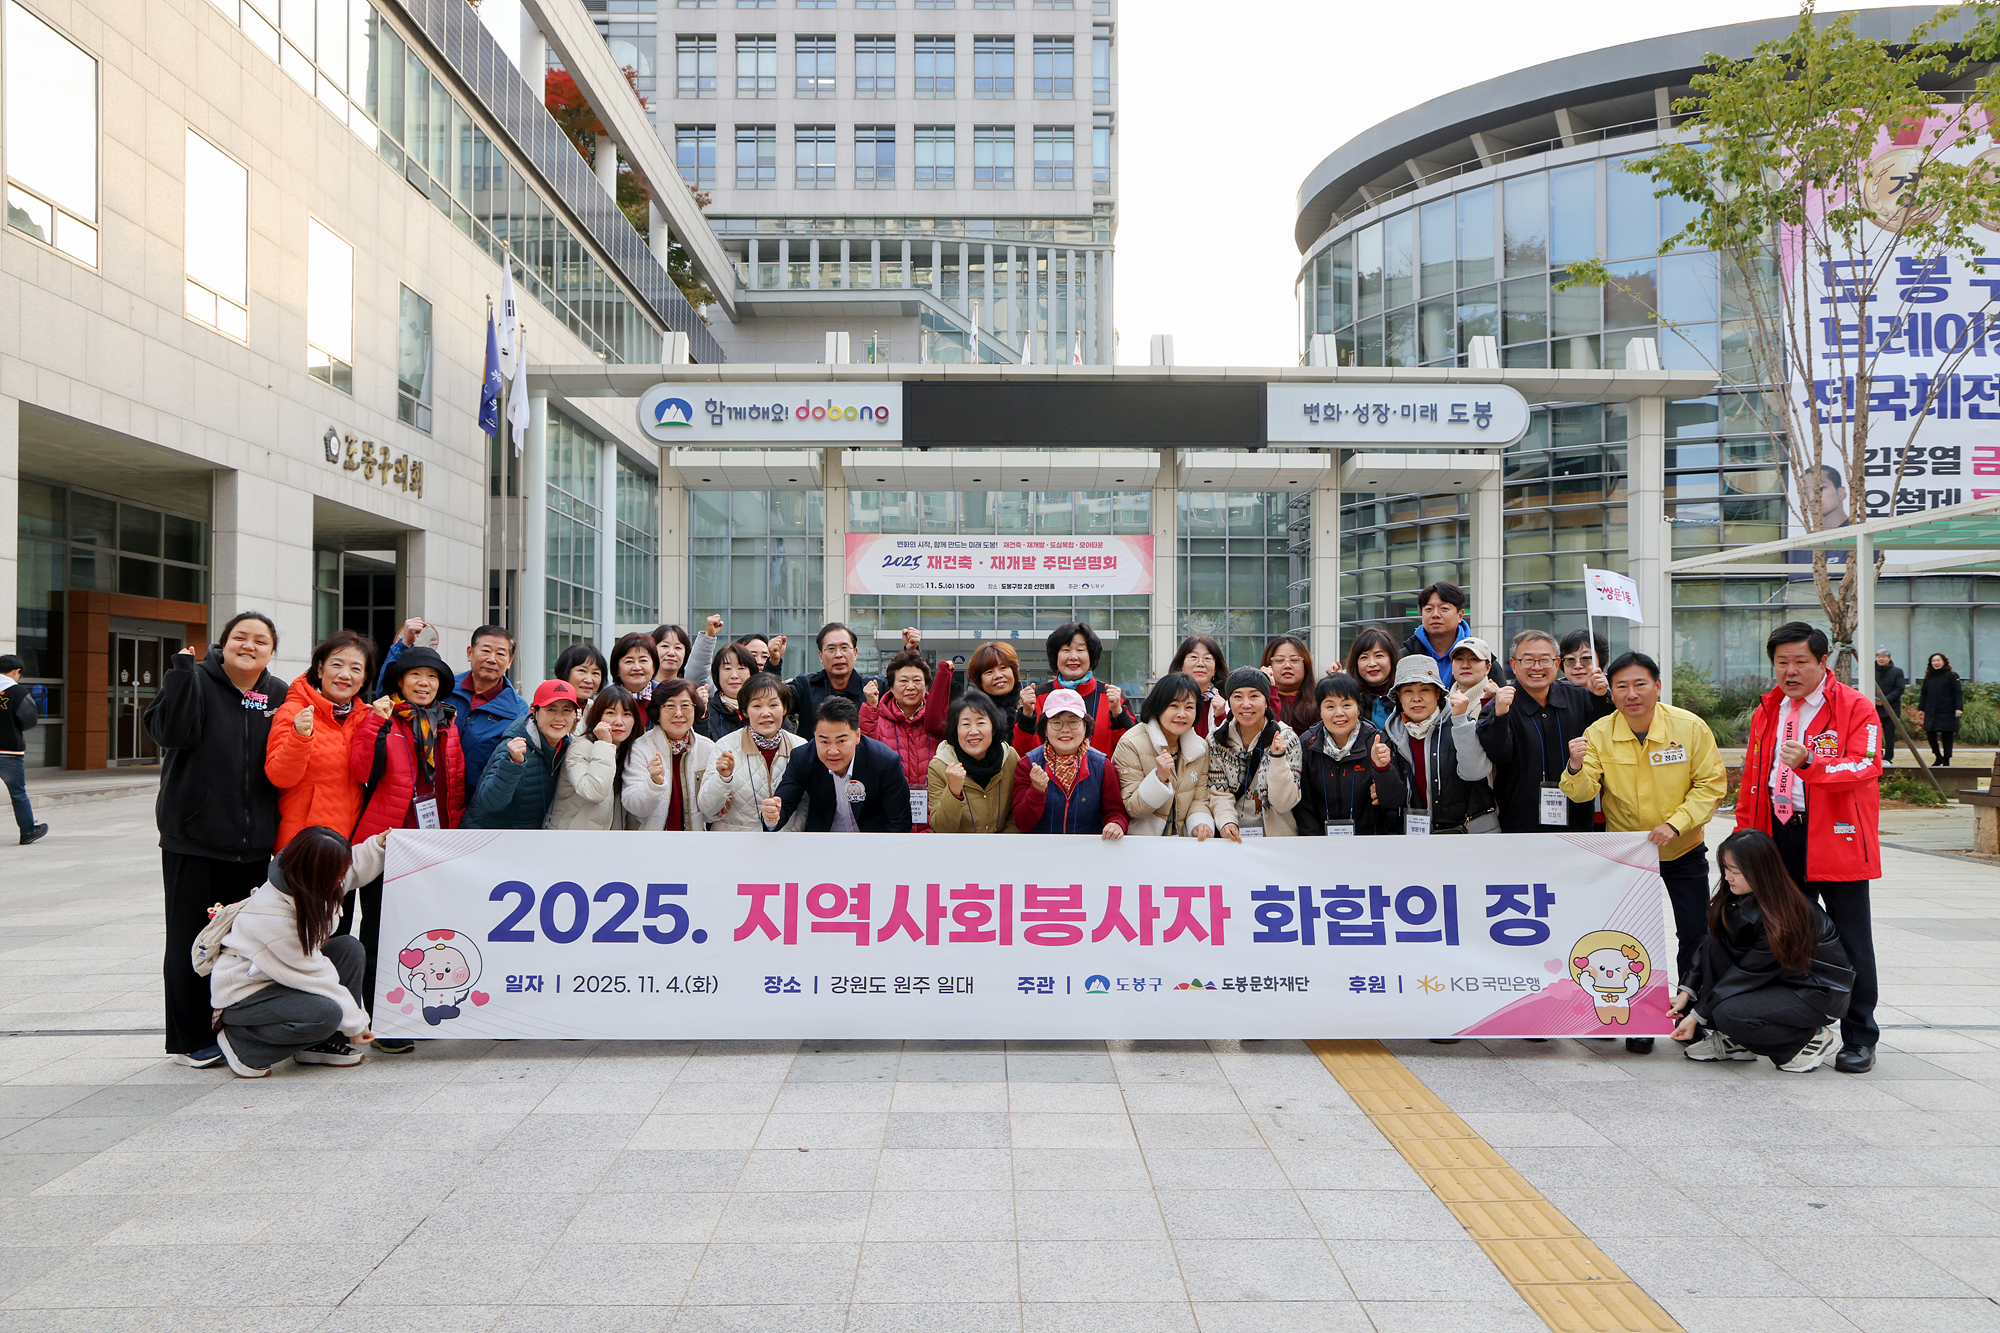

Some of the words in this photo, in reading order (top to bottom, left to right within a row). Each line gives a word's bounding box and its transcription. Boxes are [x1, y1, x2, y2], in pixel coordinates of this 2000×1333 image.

[1819, 312, 2000, 359] 브레이
[705, 398, 789, 426] 함께해요!
[796, 398, 889, 426] dobong
[1448, 401, 1493, 430] 도봉
[896, 541, 916, 549] 변화의
[882, 555, 923, 570] 2025
[927, 555, 972, 570] 재건축
[990, 555, 1037, 570] 재개발
[1043, 555, 1117, 570] 주민설명회
[487, 880, 709, 945] 2025.
[733, 882, 1231, 947] 지역사회봉사자
[1251, 884, 1460, 947] 화합의
[1486, 883, 1556, 947] 장
[505, 975, 544, 993] 일자
[573, 975, 631, 993] 2025.
[638, 975, 660, 993] 11.
[666, 975, 719, 994] 4.(화)
[764, 976, 801, 994] 장소
[831, 976, 887, 994] 강원도
[893, 976, 931, 994] 원주
[937, 976, 974, 994] 일대
[1017, 976, 1055, 994] 주관
[1116, 977, 1163, 992] 도봉구
[1222, 975, 1310, 993] 도봉문화재단
[1349, 975, 1386, 994] 후원
